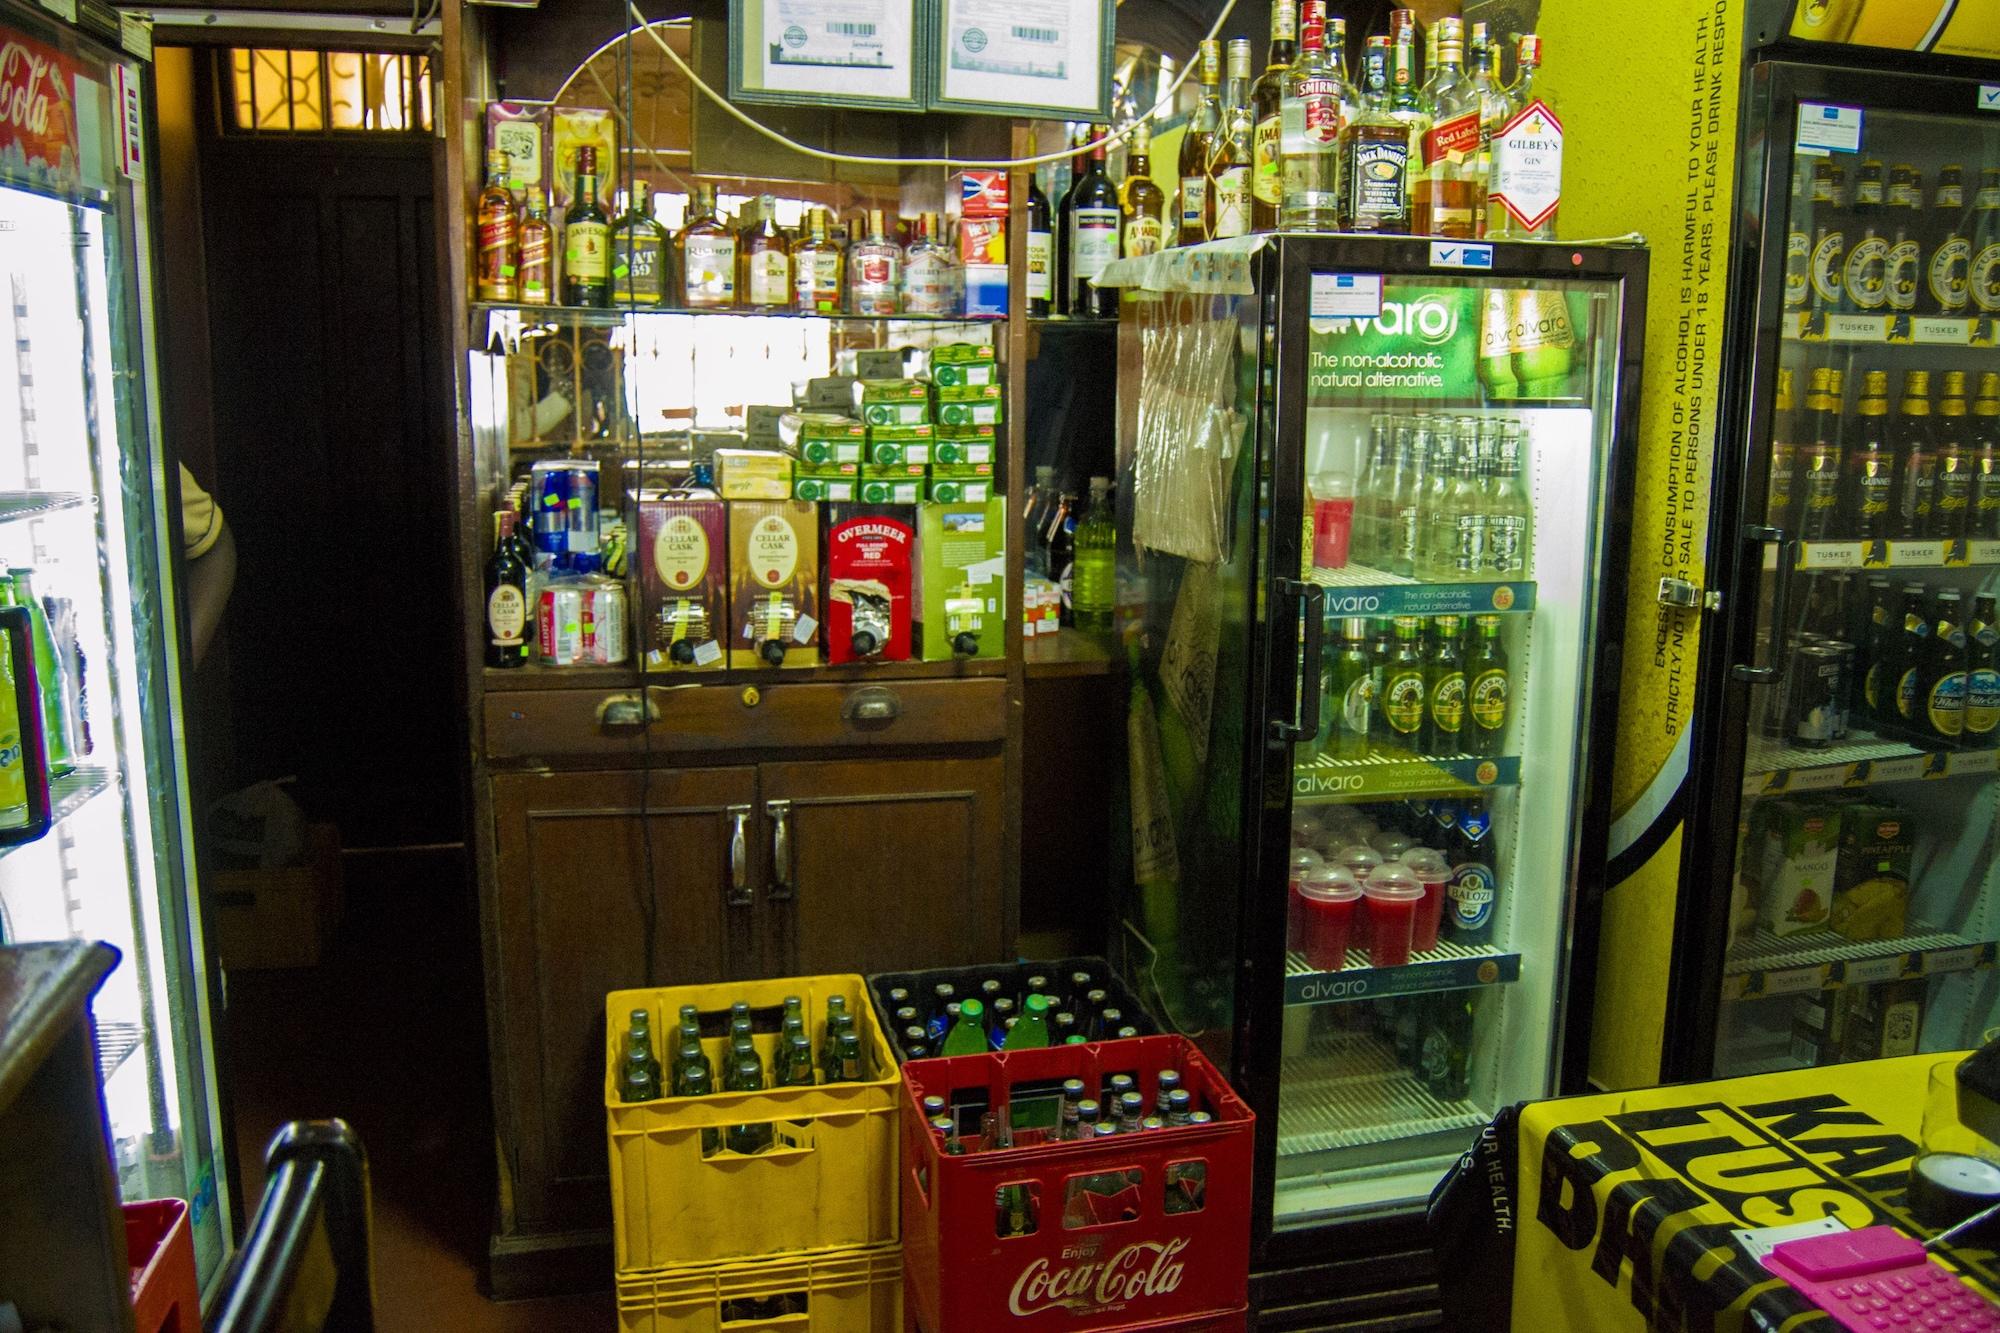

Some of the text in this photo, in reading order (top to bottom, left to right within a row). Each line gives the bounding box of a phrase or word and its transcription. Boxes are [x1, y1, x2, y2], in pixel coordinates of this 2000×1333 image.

[1707, 71, 1723, 133] DRINK
[1436, 133, 1456, 147] Red
[1455, 124, 1480, 141] Label
[1509, 139, 1558, 151] GILBEY'S
[1356, 147, 1406, 166] JACK DANIEL'S
[1524, 157, 1542, 166] GIN
[1703, 138, 1719, 212] PLEASE
[1697, 217, 1714, 287] YEARS.
[1697, 292, 1709, 317] 18
[1515, 314, 1567, 338] alvaro
[1839, 322, 1959, 335] TUSKER TUSKER
[1655, 11, 1710, 668] EXCESSE CONSUMPTION OF ALCOHOL IS HARMFUL TO YOUR HEALTH.
[1311, 352, 1445, 370] The non-alcoholic,
[1691, 322, 1708, 391] UNDER
[1311, 372, 1444, 388] natural alternative.
[1685, 395, 1702, 484] PERSONS
[1683, 489, 1695, 514] TO
[663, 534, 700, 544] CELLAR
[756, 534, 791, 543] CELLAR
[837, 523, 907, 545] OVERMEER
[1680, 519, 1694, 564] SALE
[668, 543, 694, 551] CASK
[760, 542, 785, 550] CASK
[863, 552, 882, 560] RED
[1816, 551, 1852, 560] TUSKER
[1899, 549, 1935, 558] TUSKER
[1325, 592, 1379, 614] lvaro
[1404, 591, 1419, 600] The
[1404, 602, 1430, 611] natural
[1672, 611, 1686, 648] NOT
[1665, 647, 1682, 737] STRICTLY
[1296, 774, 1364, 793] alvaro
[1451, 888, 1491, 903] BALOZI
[1301, 978, 1367, 1000] alvaro
[1487, 1159, 1513, 1234] HEALTH.
[1061, 1246, 1098, 1261] Enjoy
[1008, 1236, 1191, 1318] Coca-Cola
